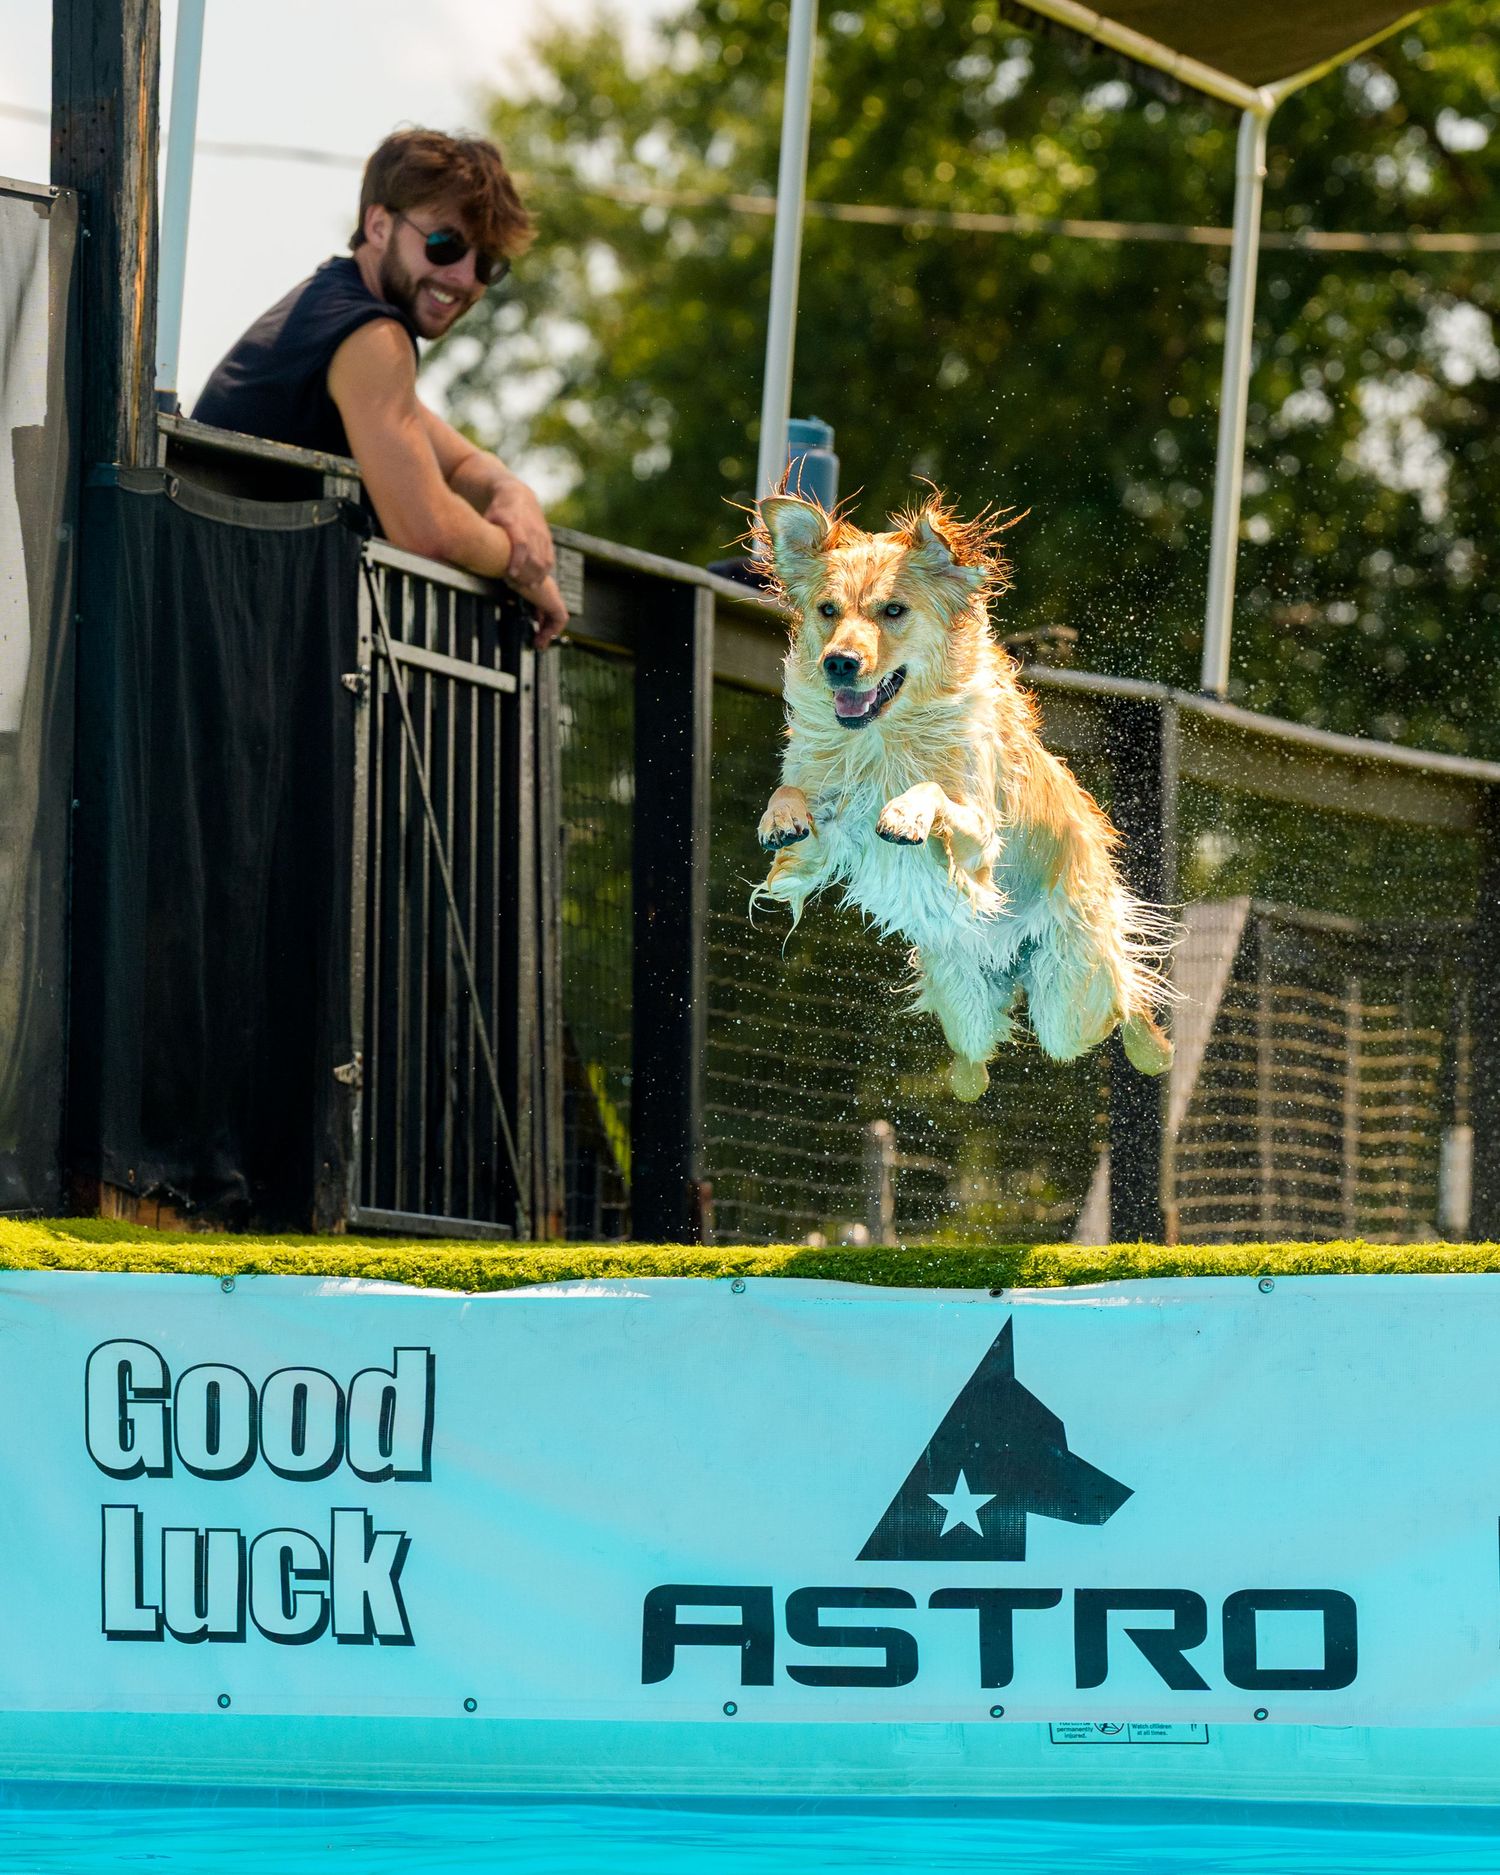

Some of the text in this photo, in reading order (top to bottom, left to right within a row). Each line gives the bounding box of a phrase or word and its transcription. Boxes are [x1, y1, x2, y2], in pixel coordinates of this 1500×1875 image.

[85, 1338, 436, 1483] Good
[101, 1503, 416, 1647] Luck
[641, 1583, 1359, 1692] ASTRO
